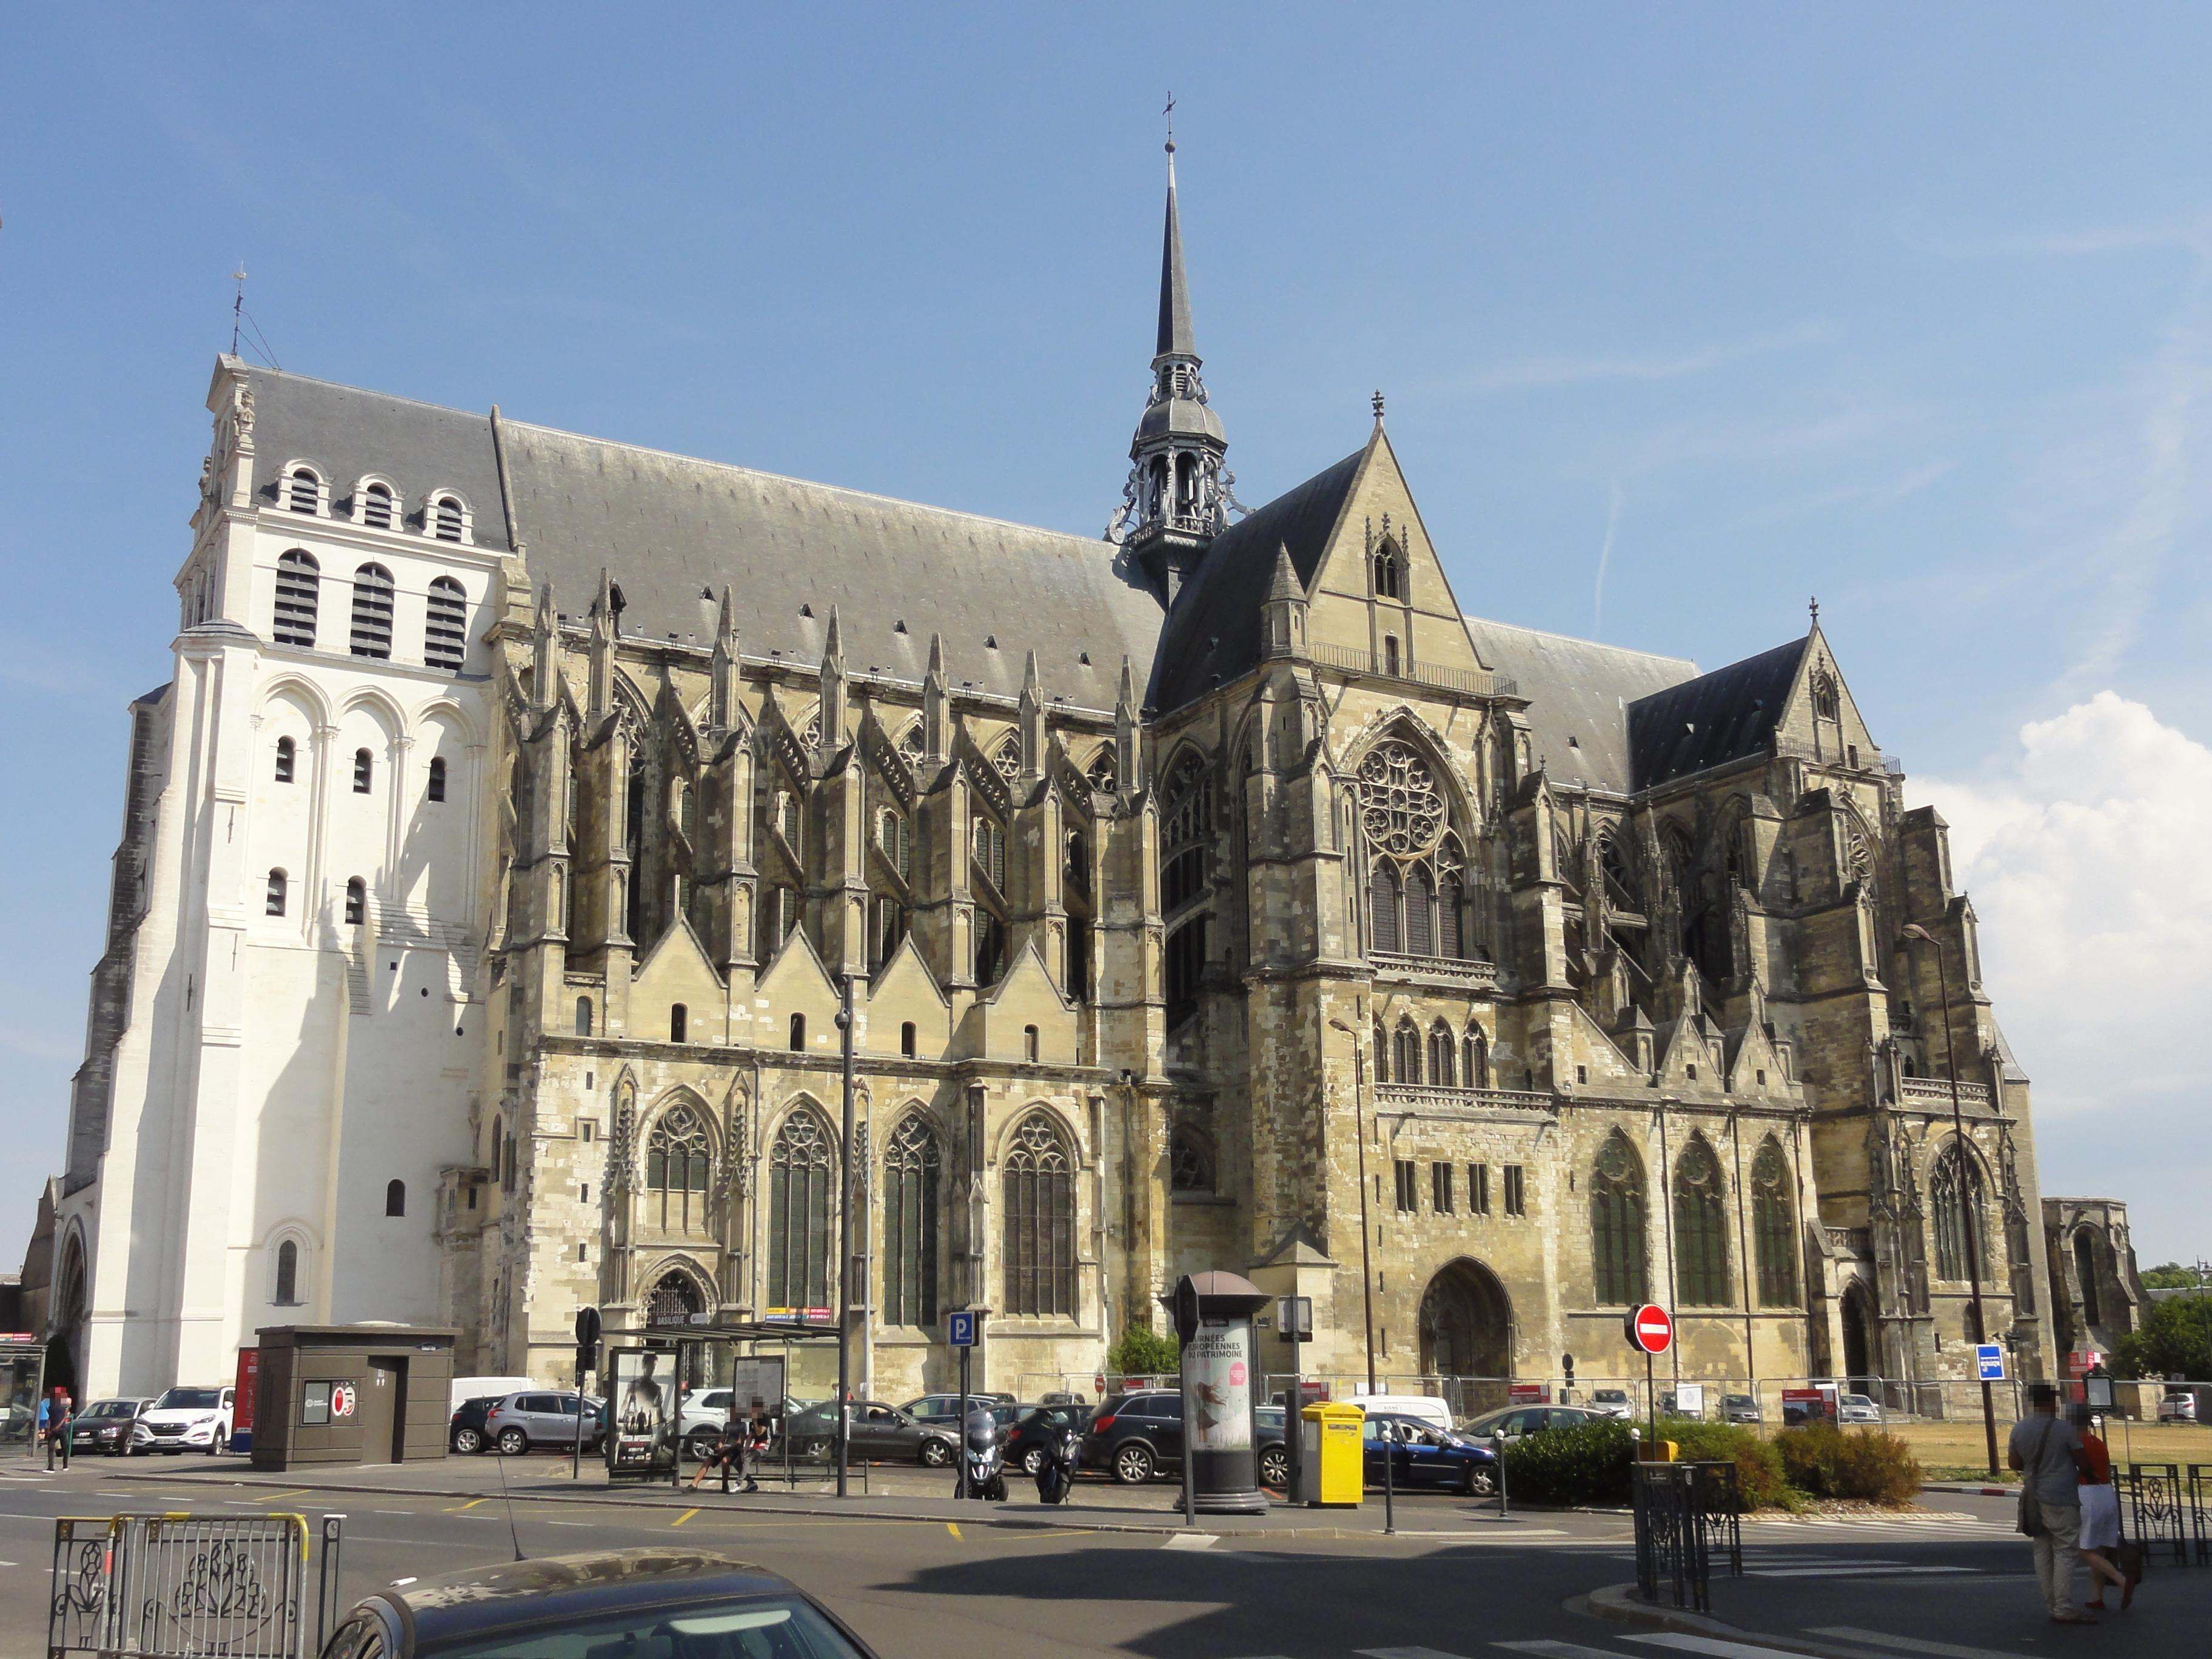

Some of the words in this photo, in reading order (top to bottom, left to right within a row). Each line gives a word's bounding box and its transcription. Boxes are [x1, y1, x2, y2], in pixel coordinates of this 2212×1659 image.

[657, 1315, 685, 1325] BASILIQUE
[956, 1319, 967, 1339] P
[1196, 1350, 1242, 1359] PATRIMOINE
